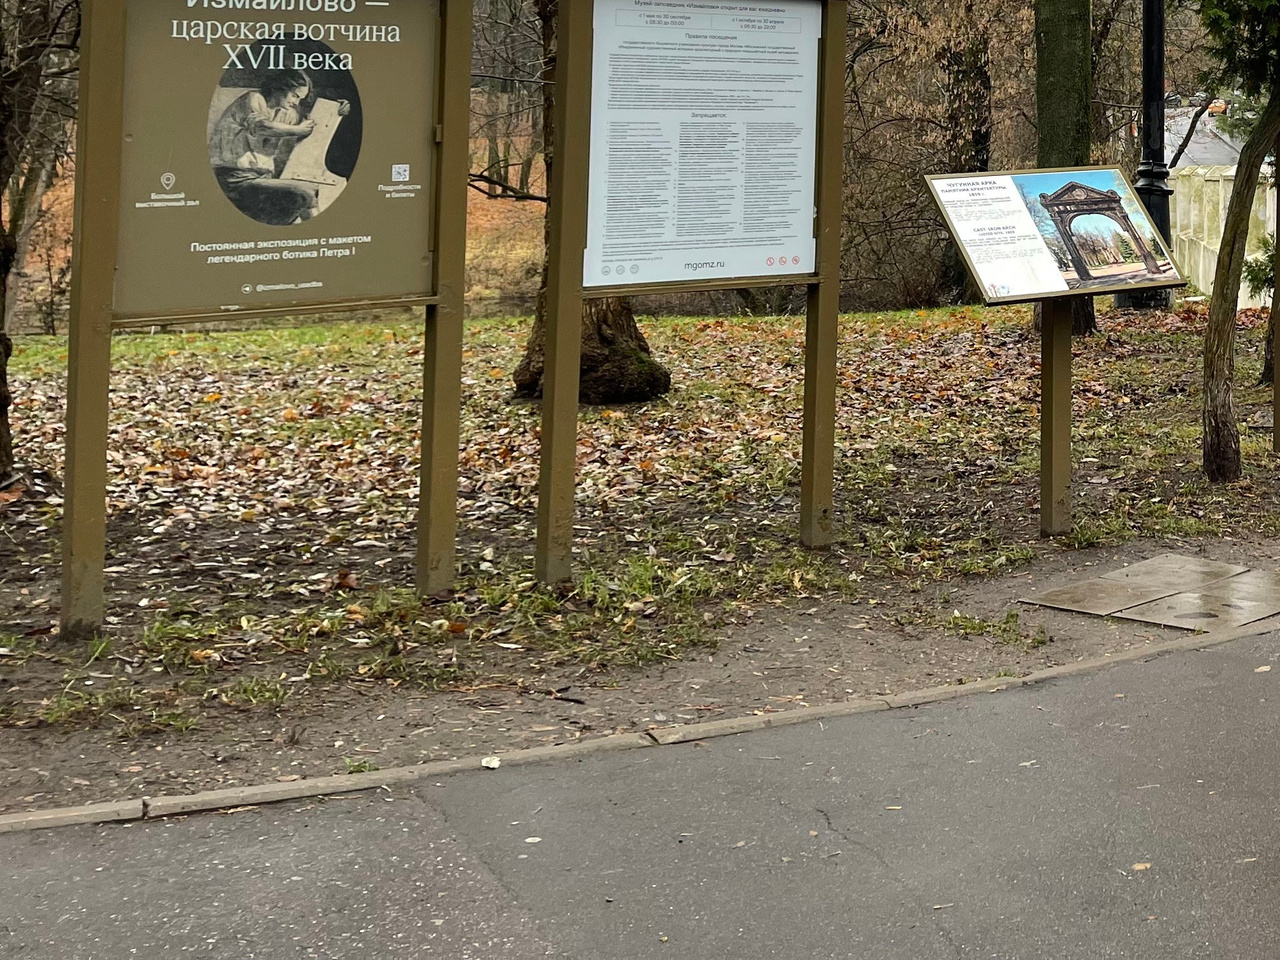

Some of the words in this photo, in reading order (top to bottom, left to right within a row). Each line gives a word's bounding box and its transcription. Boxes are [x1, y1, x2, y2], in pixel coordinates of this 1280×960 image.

[171, 20, 286, 44] царская
[292, 23, 401, 42] вотчина
[222, 44, 286, 69] XVII
[292, 52, 354, 70] века
[190, 241, 254, 252] Постоянная
[257, 238, 318, 250] экспозиция
[328, 234, 371, 245] макетом
[206, 252, 280, 264] легендарного
[282, 250, 318, 260] ботика
[319, 247, 350, 258] Петра
[684, 259, 725, 271] mgomz.ru
